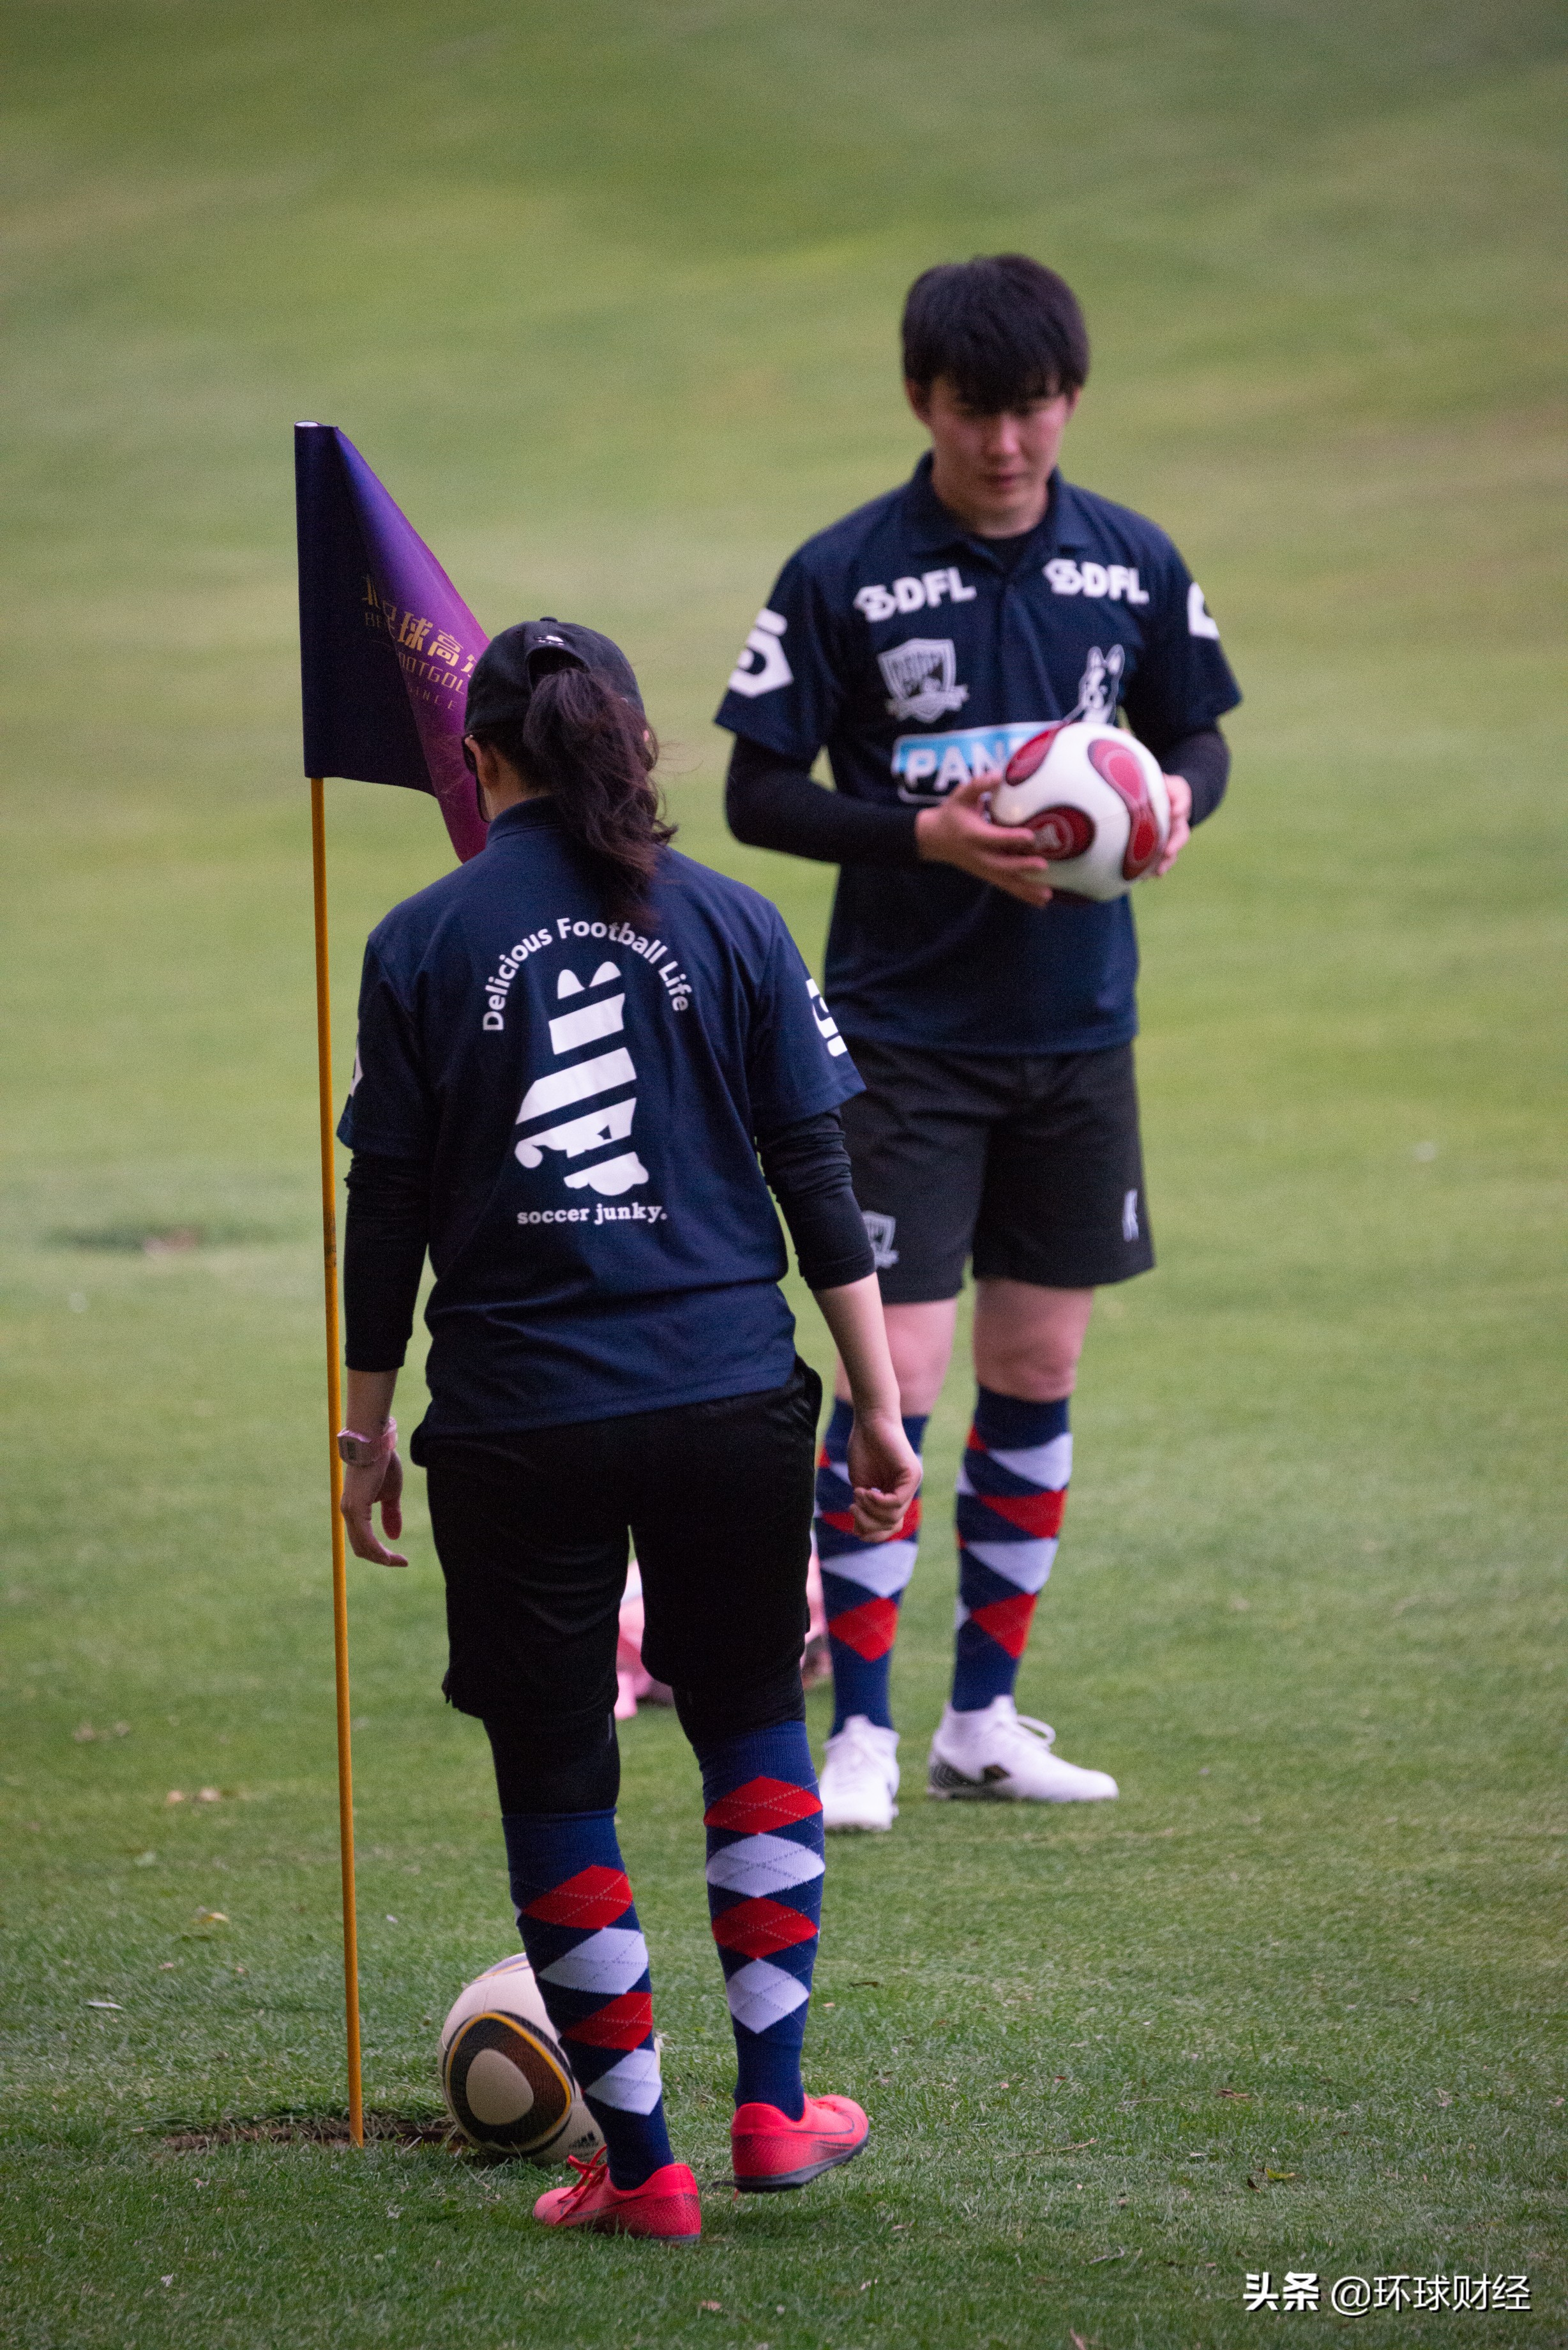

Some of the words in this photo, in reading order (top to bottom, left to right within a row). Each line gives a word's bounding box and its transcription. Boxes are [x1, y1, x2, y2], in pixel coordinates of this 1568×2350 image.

[853, 566, 977, 622] SDFL
[1043, 558, 1149, 603] SDFL
[483, 928, 552, 1031] Delicious
[557, 918, 668, 964] Football
[658, 960, 692, 1012] Life
[516, 1208, 589, 1225] soccer
[594, 1202, 667, 1225] junky.
